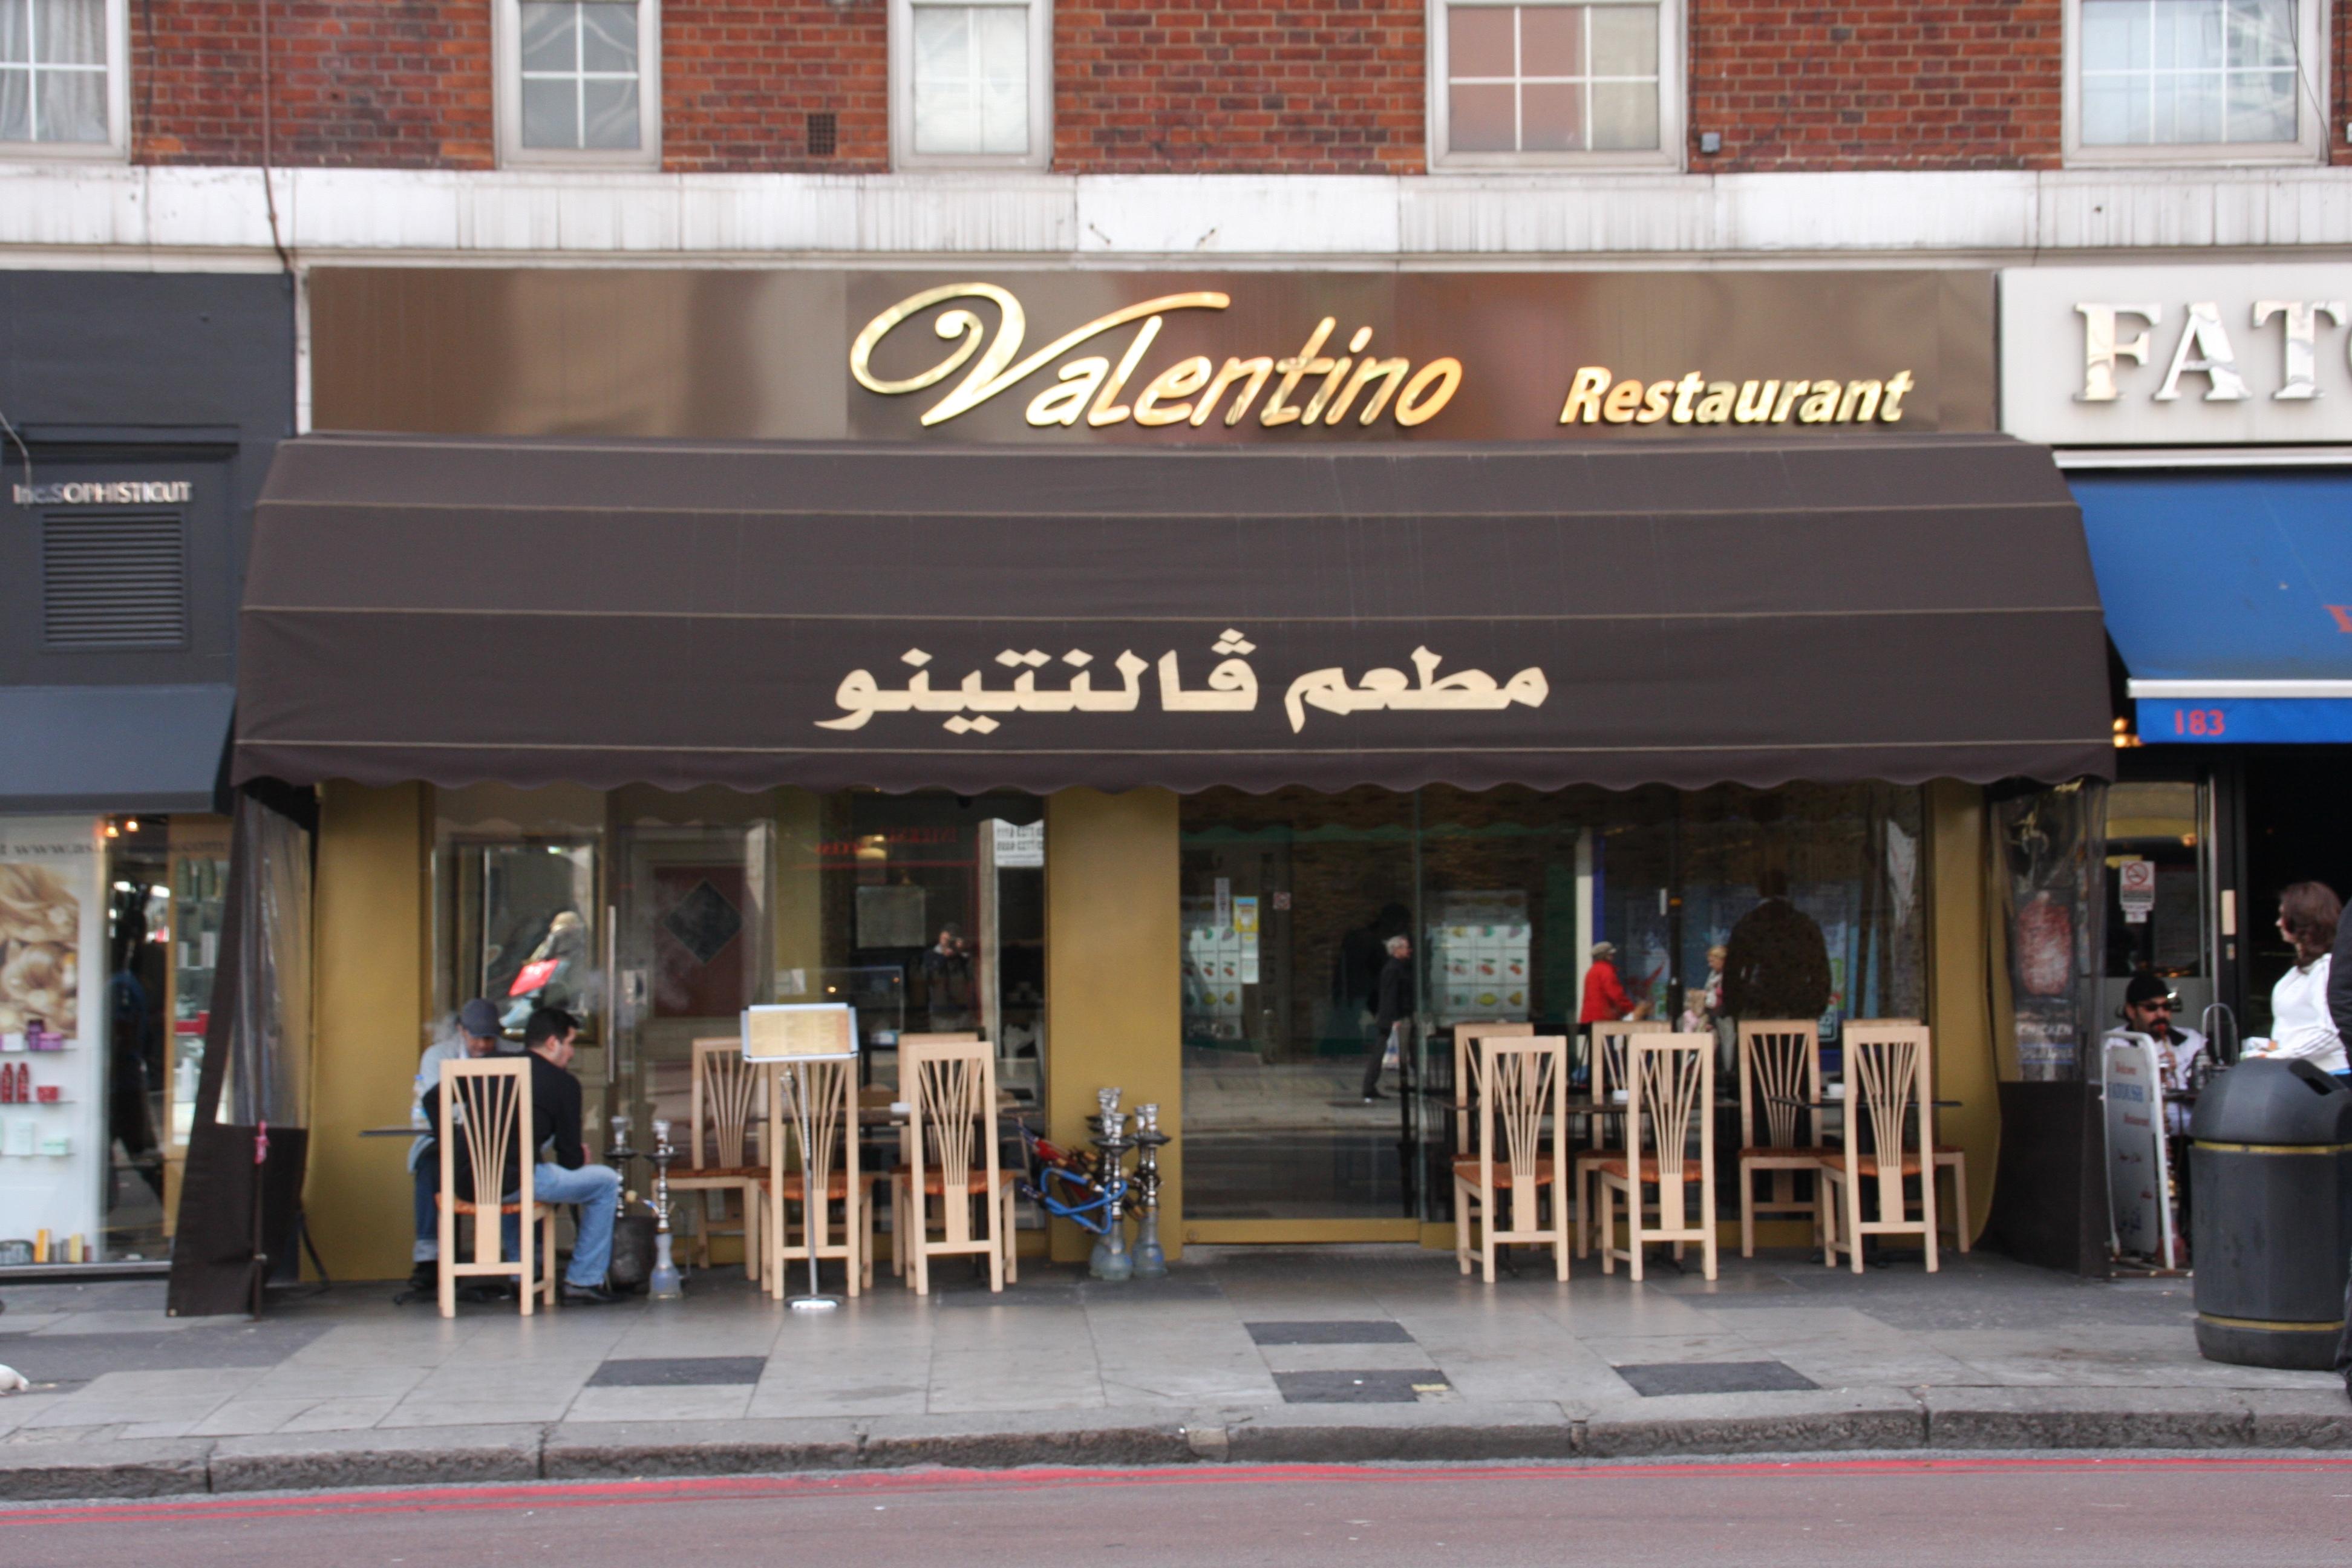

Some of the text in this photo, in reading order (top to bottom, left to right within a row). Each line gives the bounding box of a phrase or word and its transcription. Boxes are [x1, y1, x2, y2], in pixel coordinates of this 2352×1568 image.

[850, 282, 1915, 426] Valentino Restaurant
[2071, 301, 2352, 402] FAT
[1284, 645, 1549, 734] مطعم
[2175, 709, 2225, 736] 183
